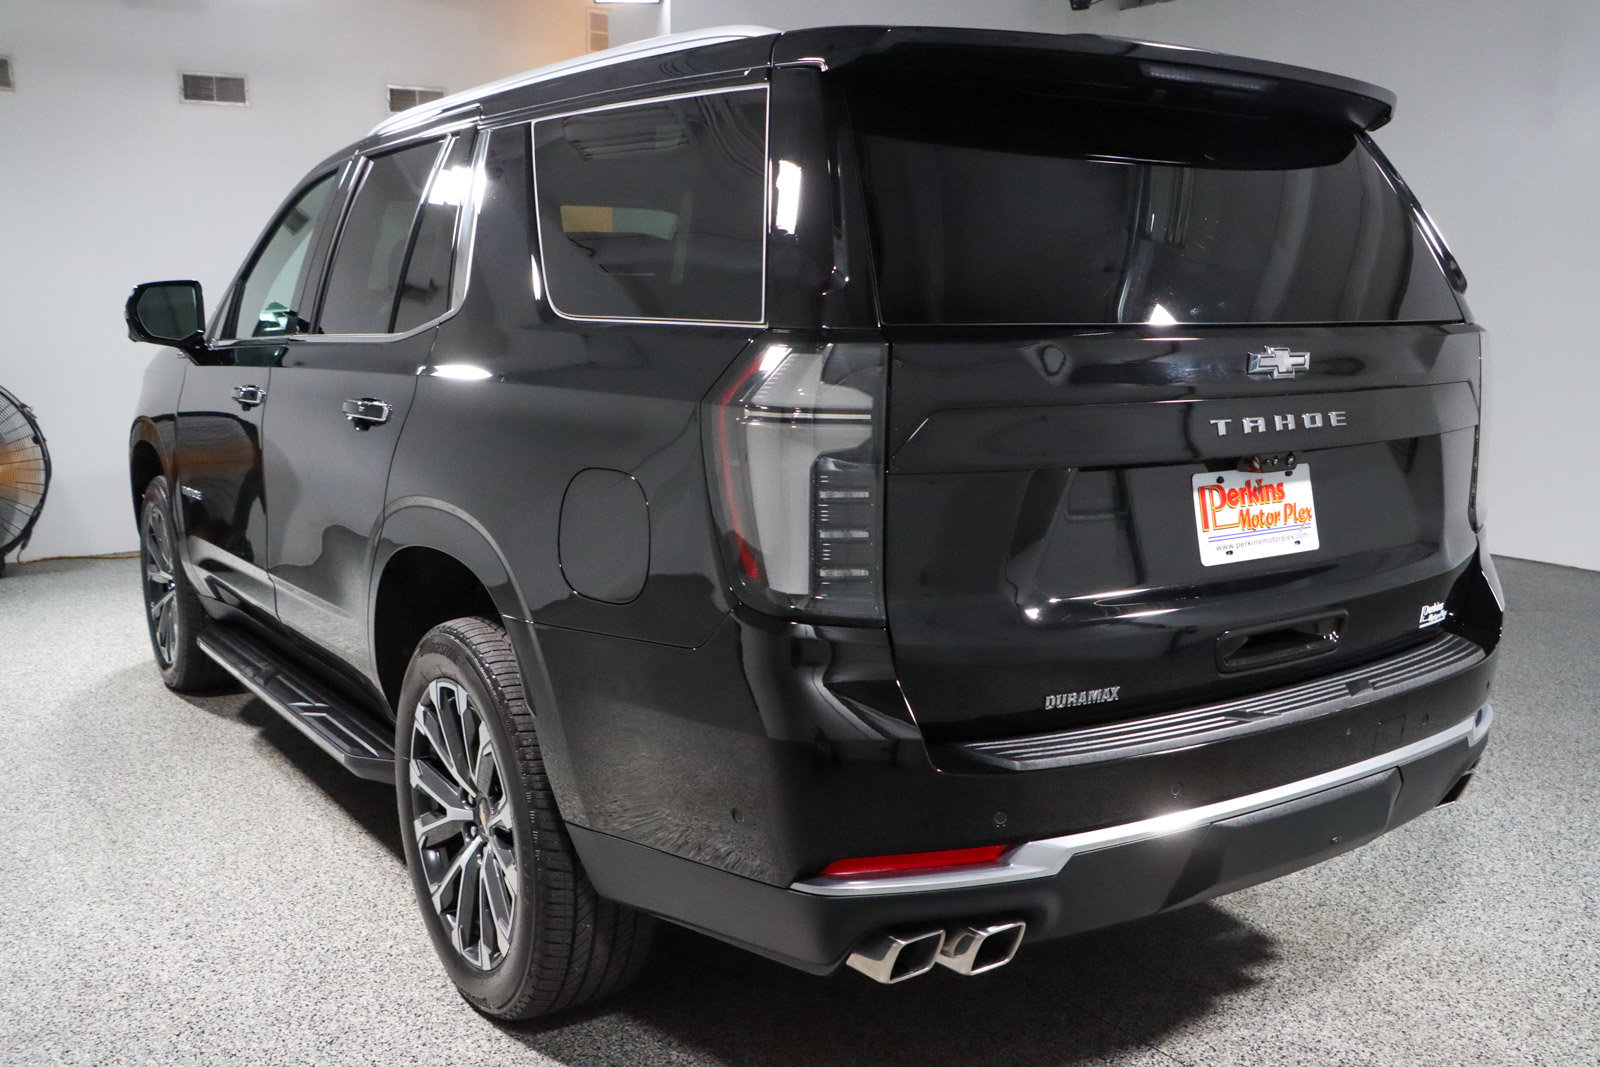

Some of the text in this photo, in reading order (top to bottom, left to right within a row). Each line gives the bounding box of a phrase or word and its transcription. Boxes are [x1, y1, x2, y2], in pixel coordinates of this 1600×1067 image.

[1210, 411, 1346, 436] TAHOE
[1198, 479, 1285, 532] Perkins
[1239, 502, 1313, 531] Motor Plex
[1216, 532, 1309, 551] www.perkinsmotorplex.com
[1044, 686, 1121, 711] DURAMAX
